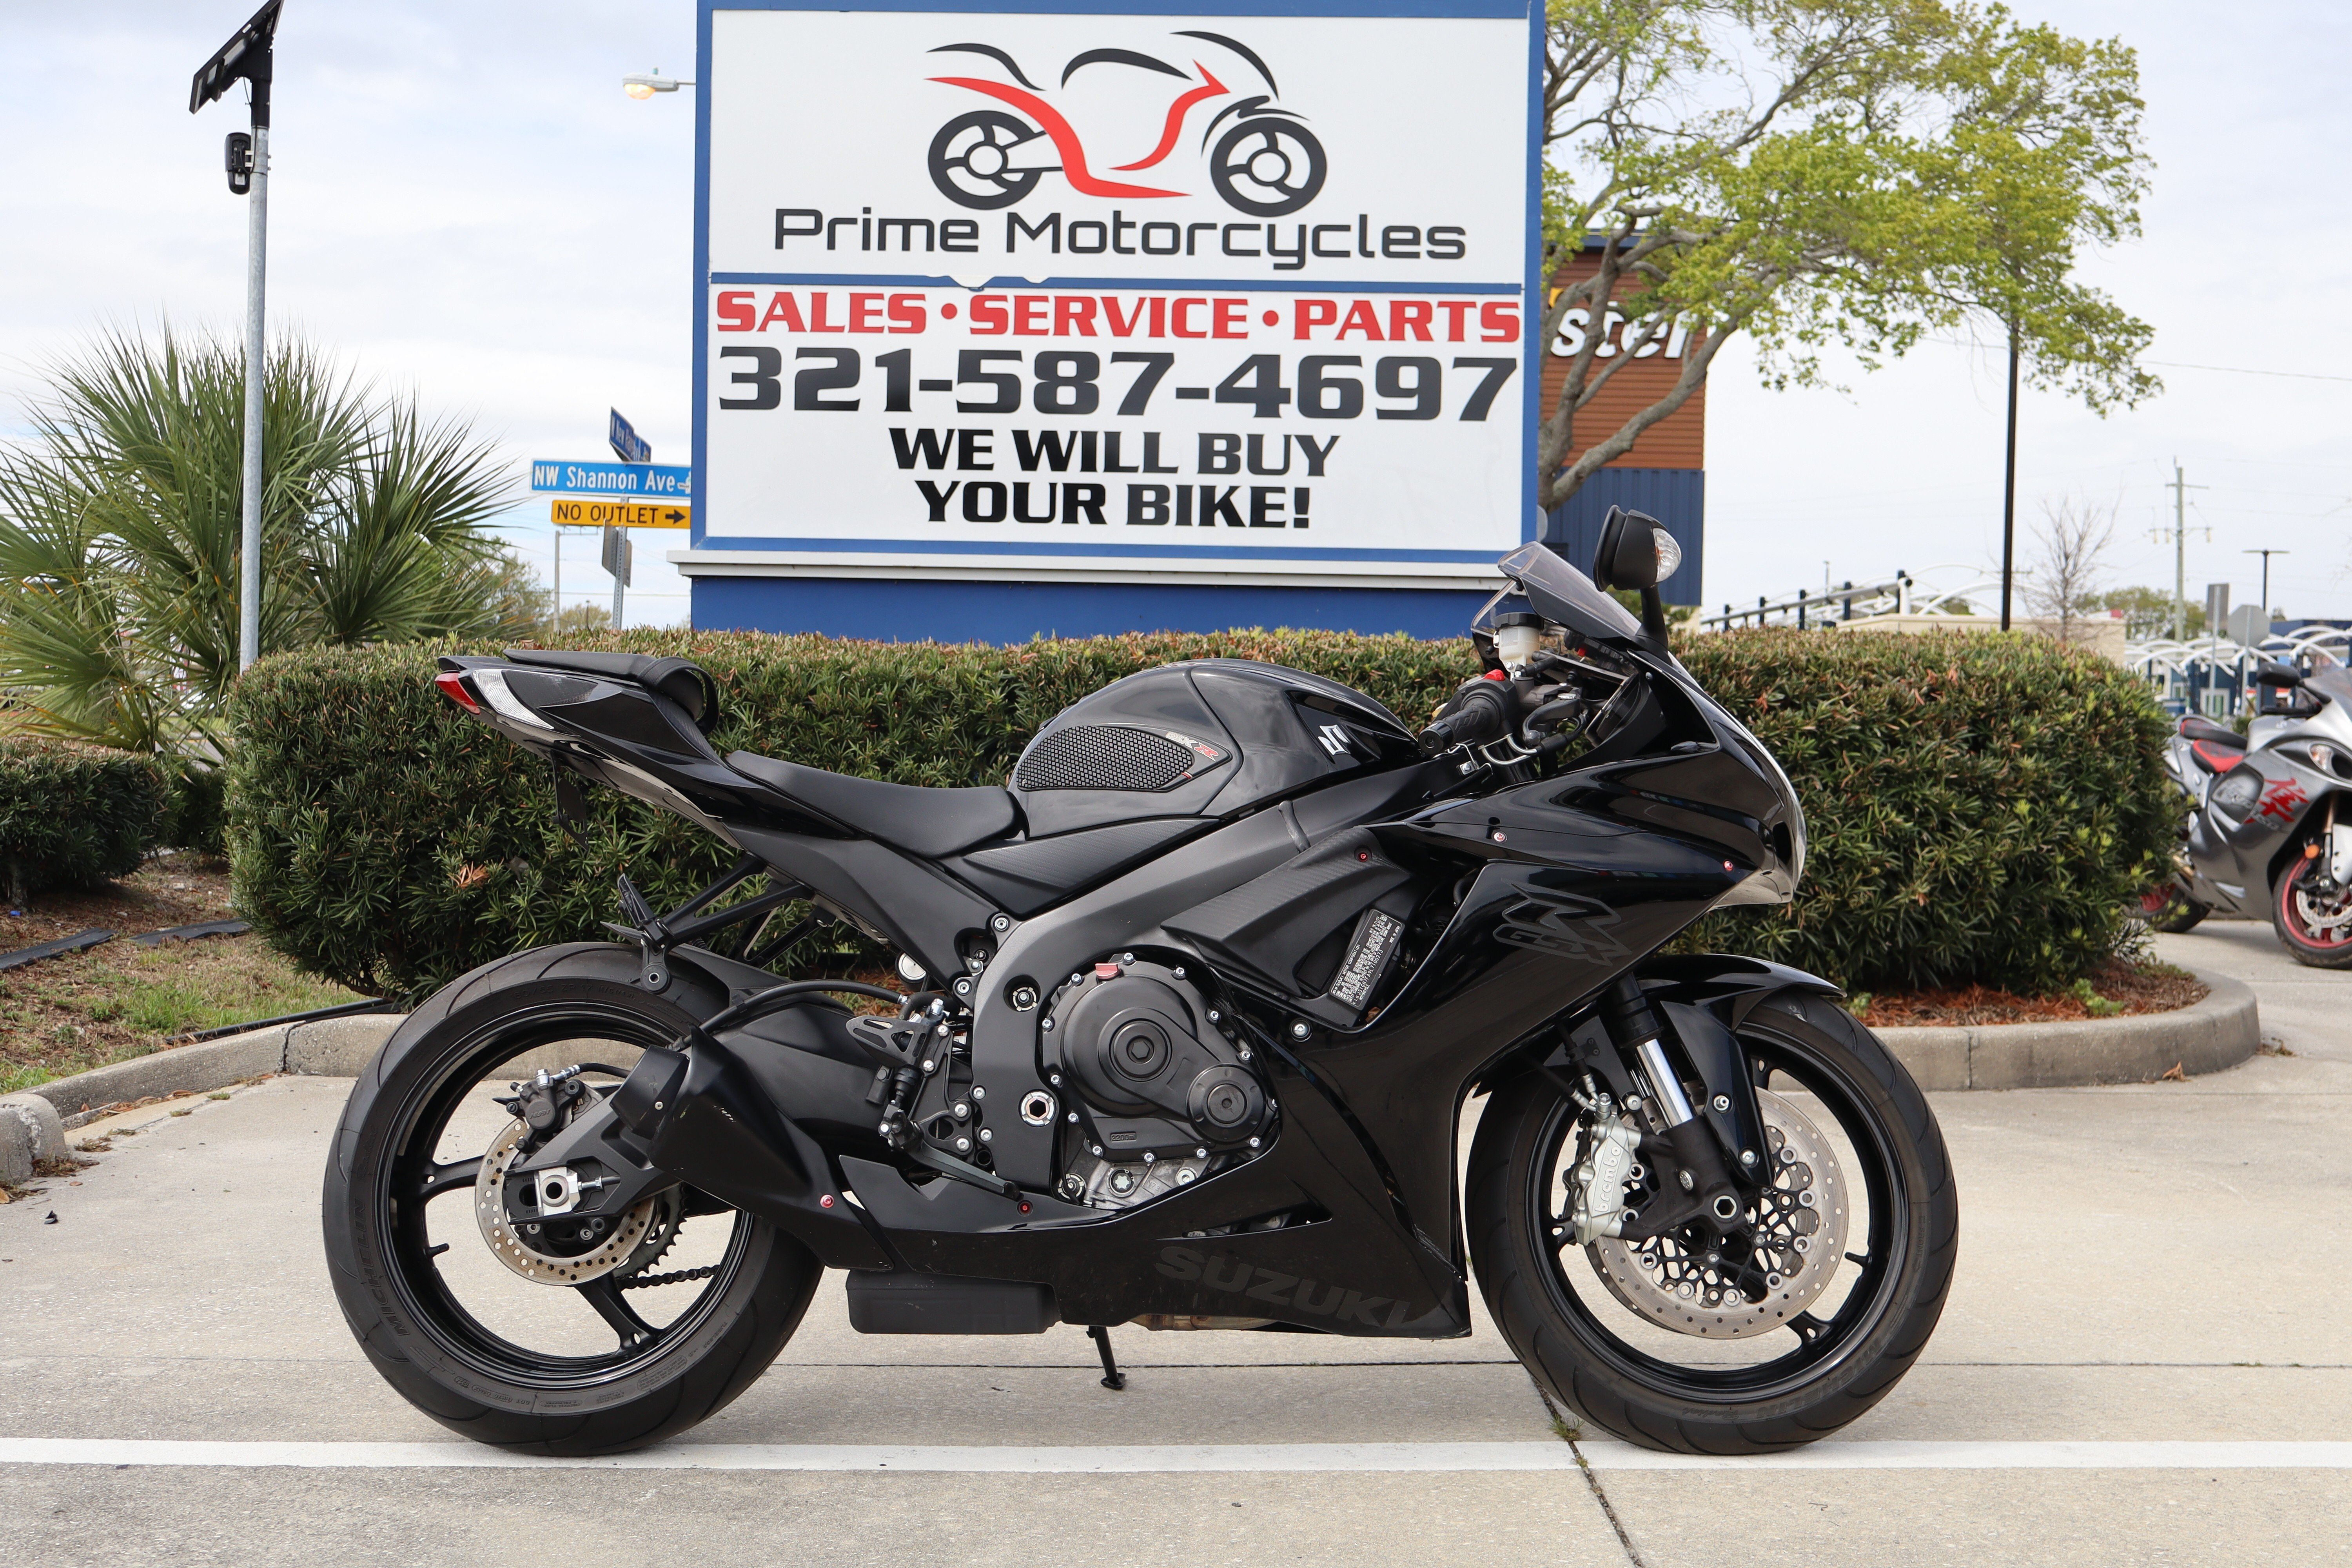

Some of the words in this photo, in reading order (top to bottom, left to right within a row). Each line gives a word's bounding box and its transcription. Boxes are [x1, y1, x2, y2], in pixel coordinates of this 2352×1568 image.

[775, 207, 978, 252] Prime
[1007, 211, 1465, 270] Motorcycles
[717, 291, 926, 334] SALES
[970, 294, 1248, 339] SERVICE
[1294, 299, 1520, 343] PARTS
[719, 347, 1517, 421] 321-587-4697
[534, 465, 559, 486] NW
[566, 466, 637, 490] Shannon
[645, 470, 675, 492] Ave
[889, 428, 994, 470] WE
[1012, 430, 1178, 474] WILL
[1198, 433, 1339, 476] BUY
[557, 504, 581, 521] NO
[590, 505, 659, 524] OUTLET
[915, 480, 1107, 524] YOUR
[1127, 484, 1310, 528] BIKE!
[1594, 1146, 1621, 1212] brembo
[351, 1198, 411, 1340] MICHELIN
[1156, 1246, 1410, 1328] SUZUKI
